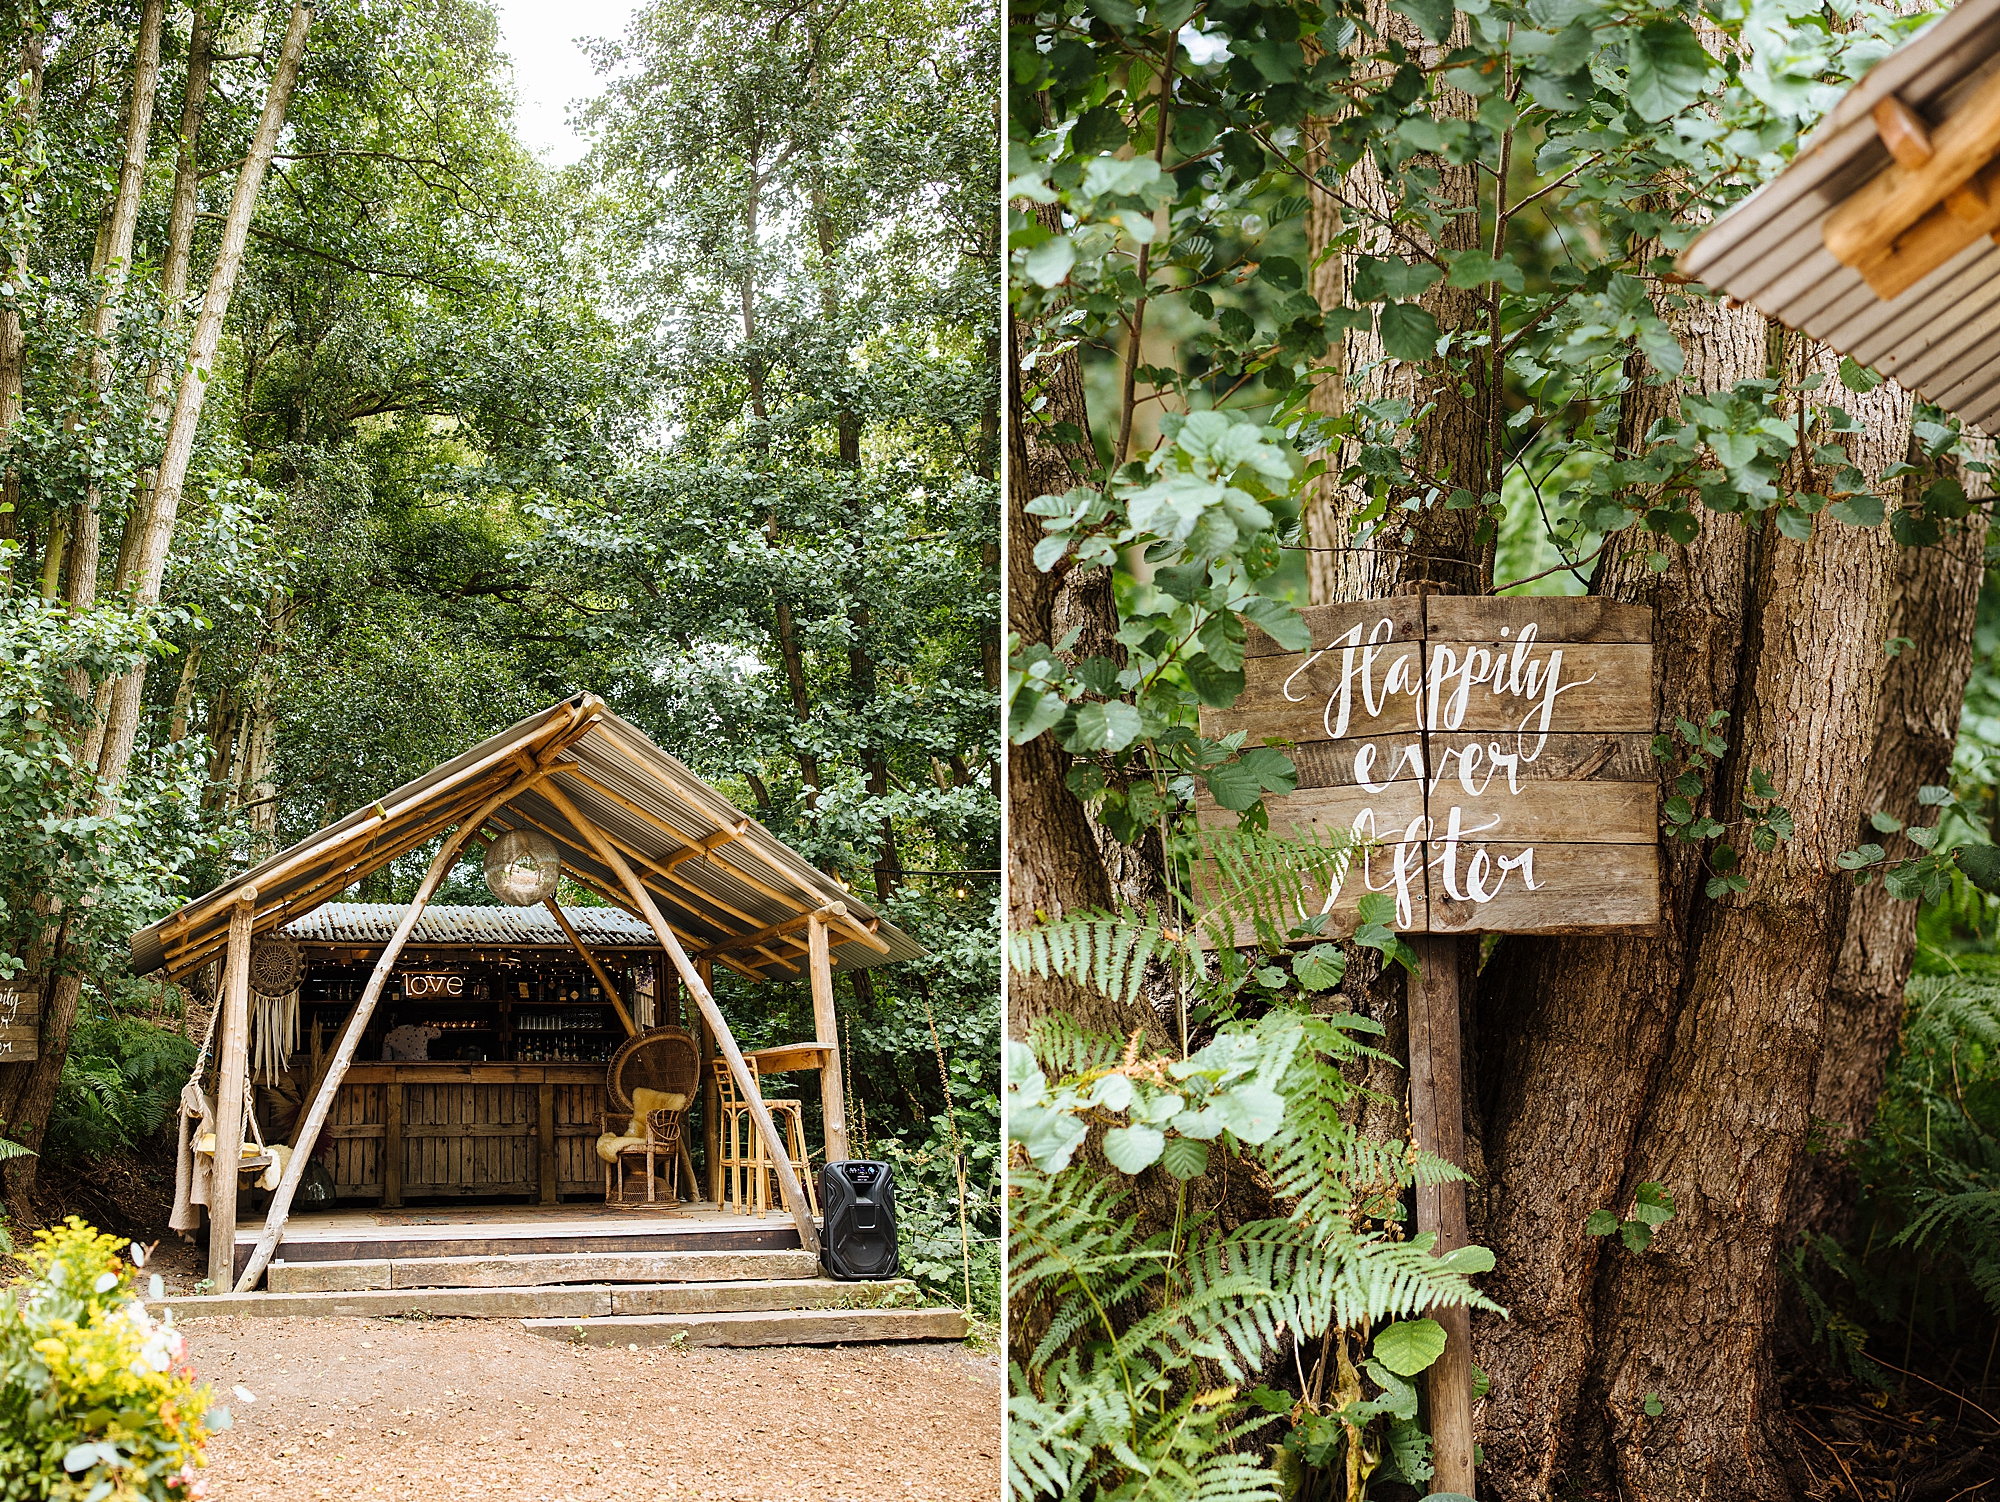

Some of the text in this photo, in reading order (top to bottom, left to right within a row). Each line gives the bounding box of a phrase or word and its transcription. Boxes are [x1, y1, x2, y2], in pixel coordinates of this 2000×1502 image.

[1283, 617, 1597, 763] Happily
[1353, 740, 1527, 797] ever
[1286, 806, 1546, 931] After
[402, 973, 463, 996] love
